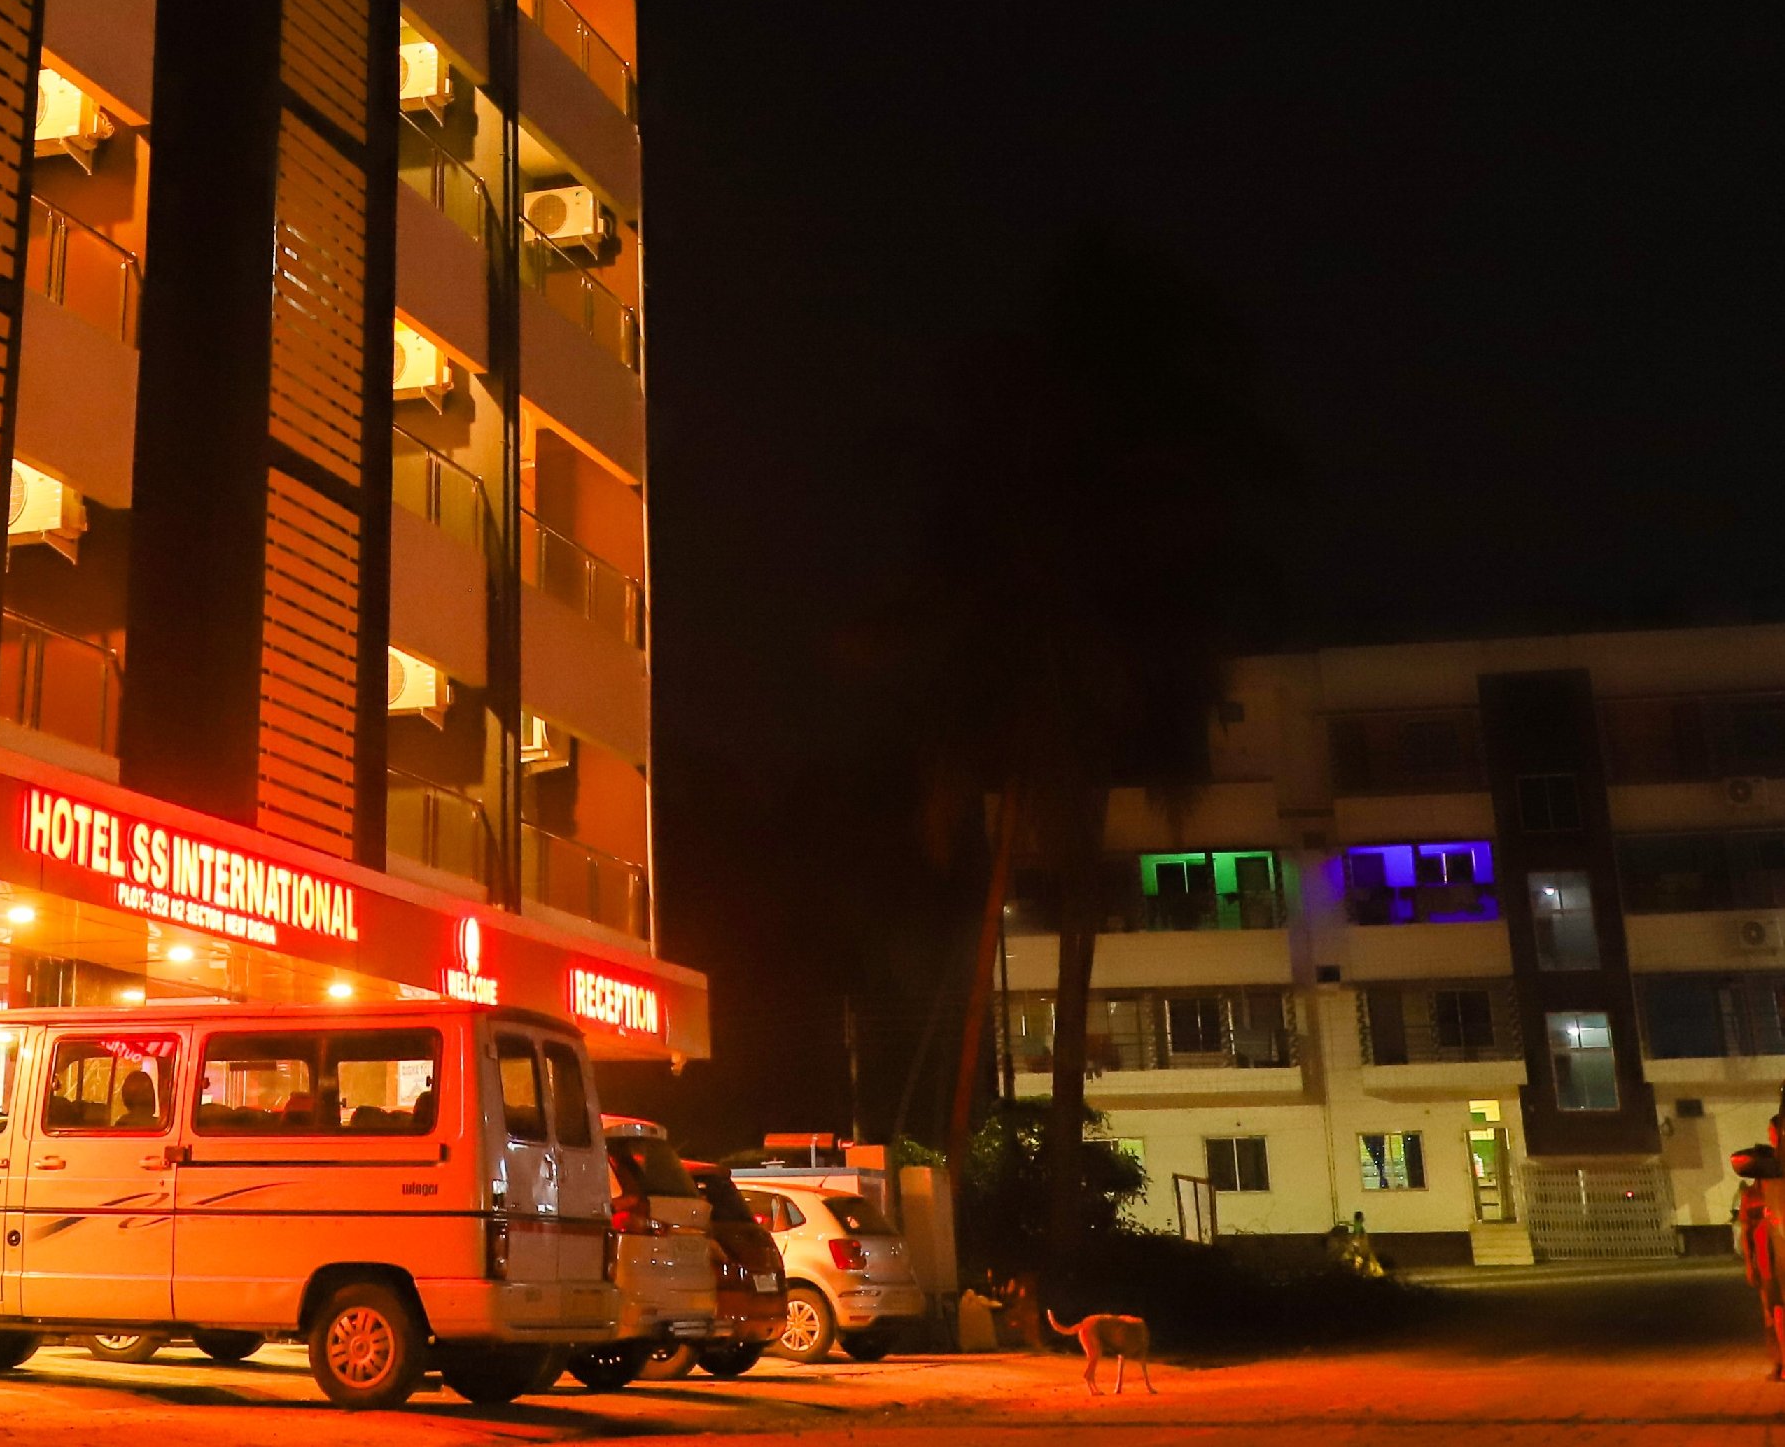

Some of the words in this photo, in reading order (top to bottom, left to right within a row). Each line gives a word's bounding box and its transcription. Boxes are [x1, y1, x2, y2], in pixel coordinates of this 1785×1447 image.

[29, 789, 126, 877] HOTEL
[132, 823, 169, 890] SS
[173, 836, 359, 941] INTERNATIONAL
[186, 901, 224, 933] SECTOR
[447, 968, 499, 1006] WELCOME
[574, 968, 658, 1034] RECEPTION
